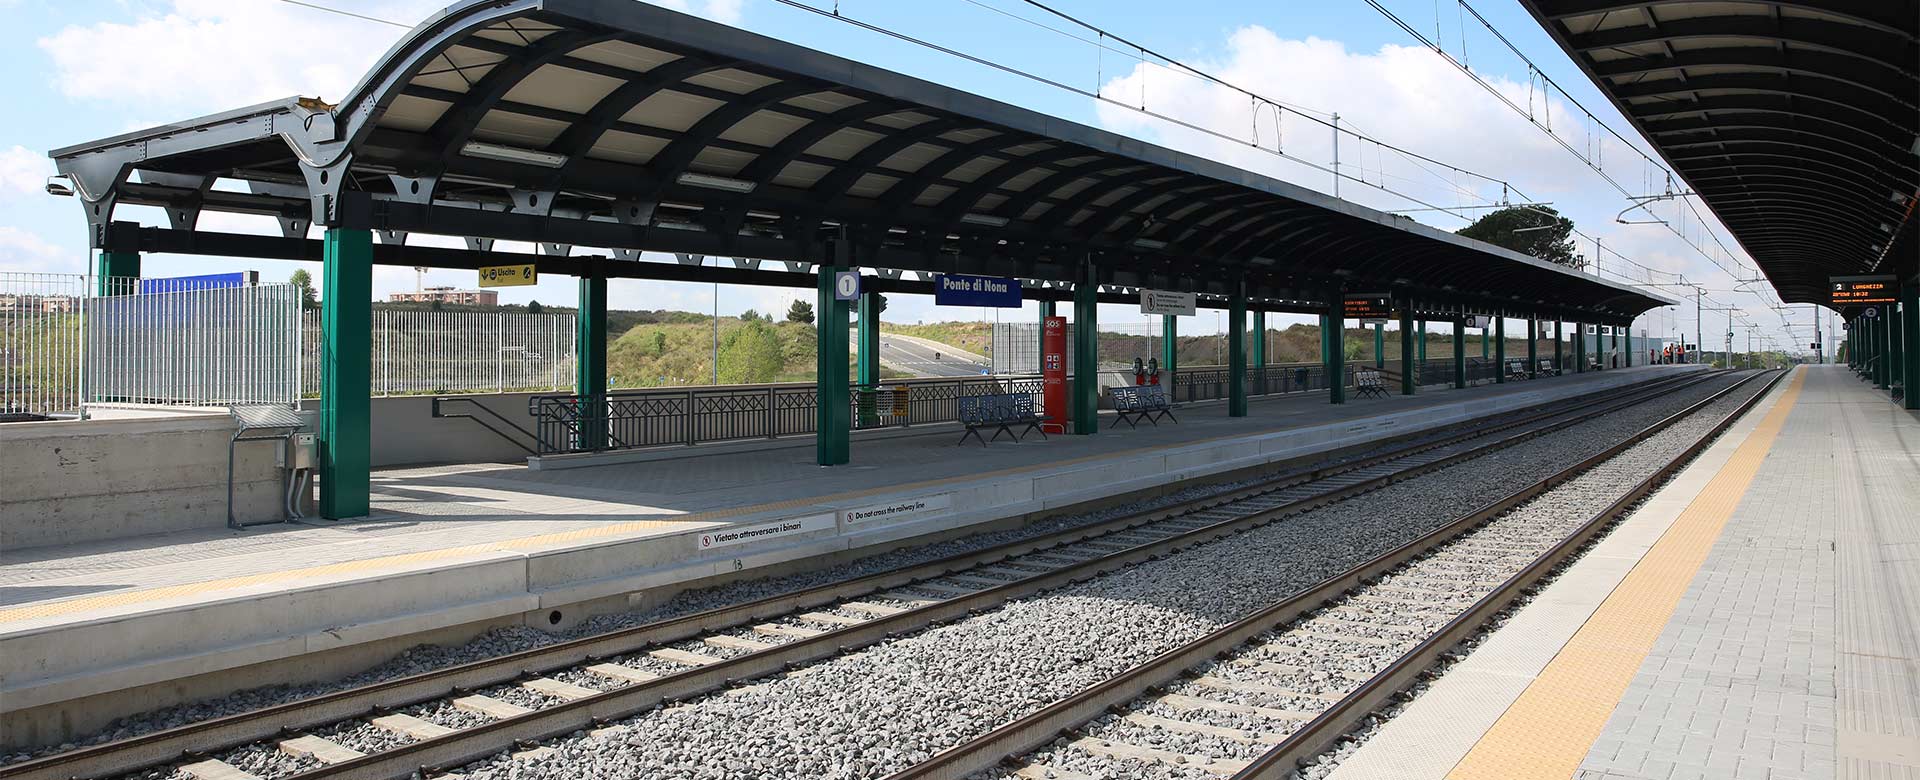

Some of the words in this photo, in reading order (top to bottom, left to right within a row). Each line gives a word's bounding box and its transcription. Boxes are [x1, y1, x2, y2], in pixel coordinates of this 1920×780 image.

[497, 267, 516, 276] Uscita
[943, 277, 970, 291] Ponte
[973, 278, 982, 291] di
[984, 279, 1008, 293] Nona
[1046, 320, 1062, 328] SOS
[873, 509, 887, 517] cross
[887, 506, 896, 514] the
[896, 503, 915, 512] railway
[714, 533, 739, 543] Vietato
[739, 527, 779, 538] attraversare
[783, 521, 802, 532] binari
